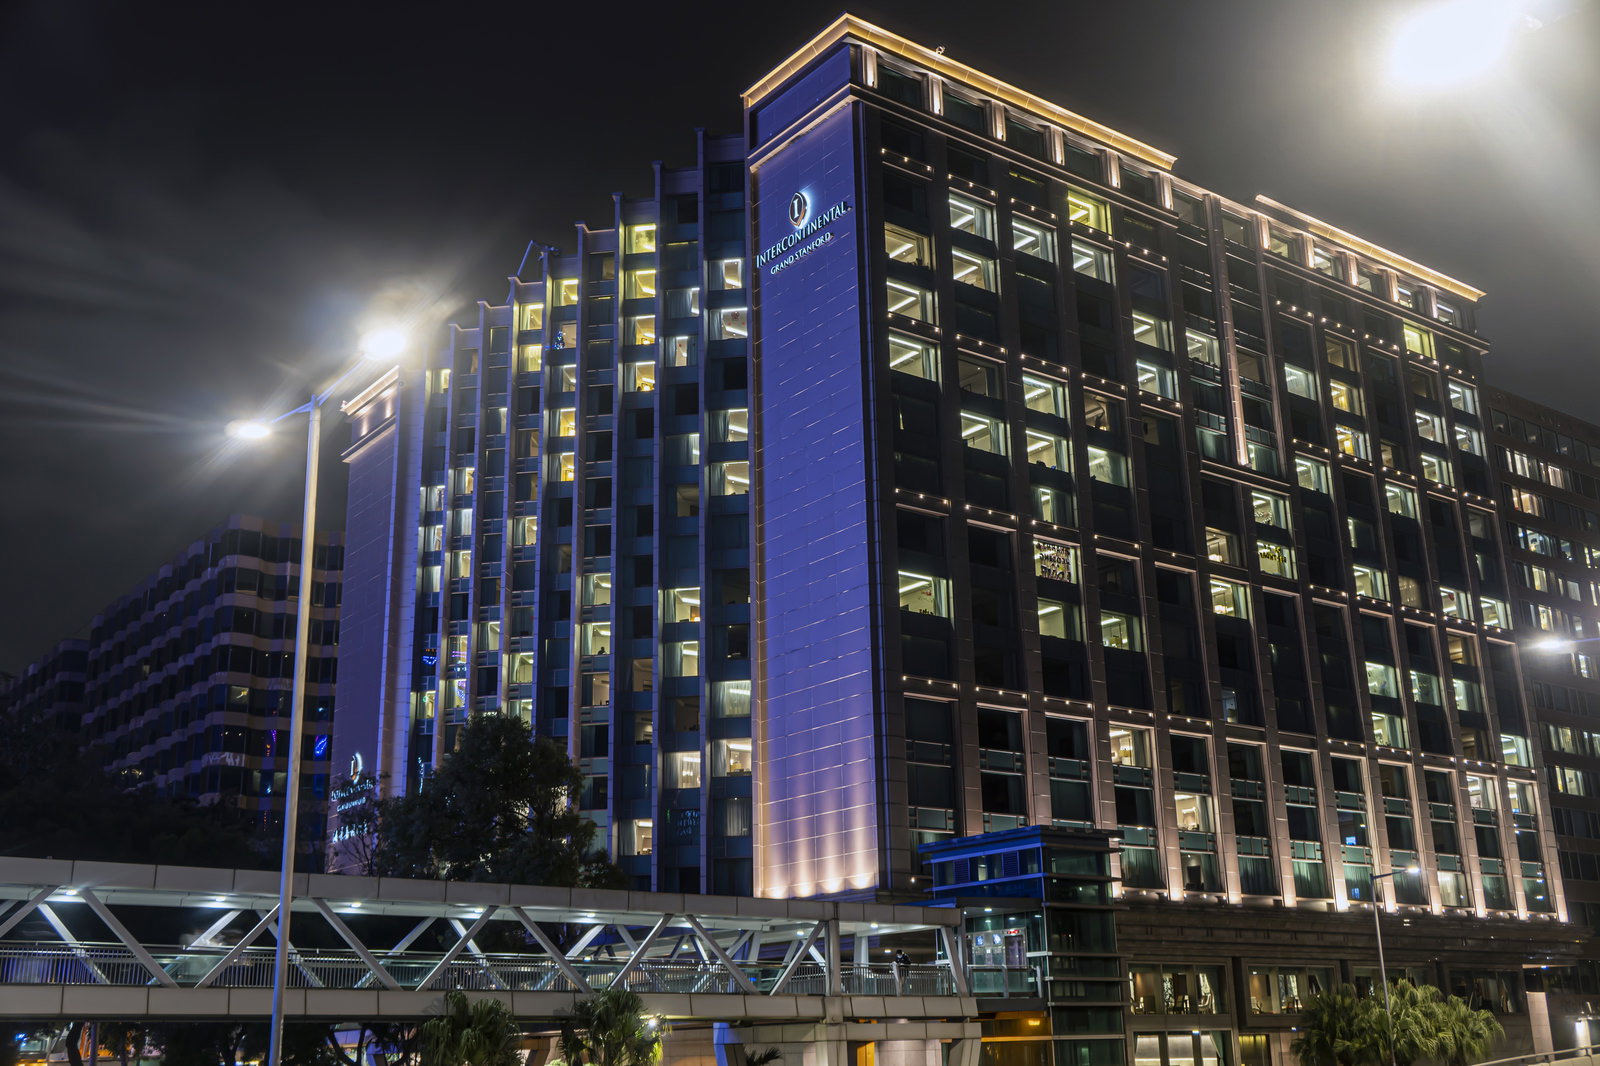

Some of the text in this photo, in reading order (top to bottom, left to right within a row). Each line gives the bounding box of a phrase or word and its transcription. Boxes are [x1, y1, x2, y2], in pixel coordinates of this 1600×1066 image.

[756, 201, 849, 268] INTERCONTINENTAL
[770, 232, 831, 275] GRAND STANFORD
